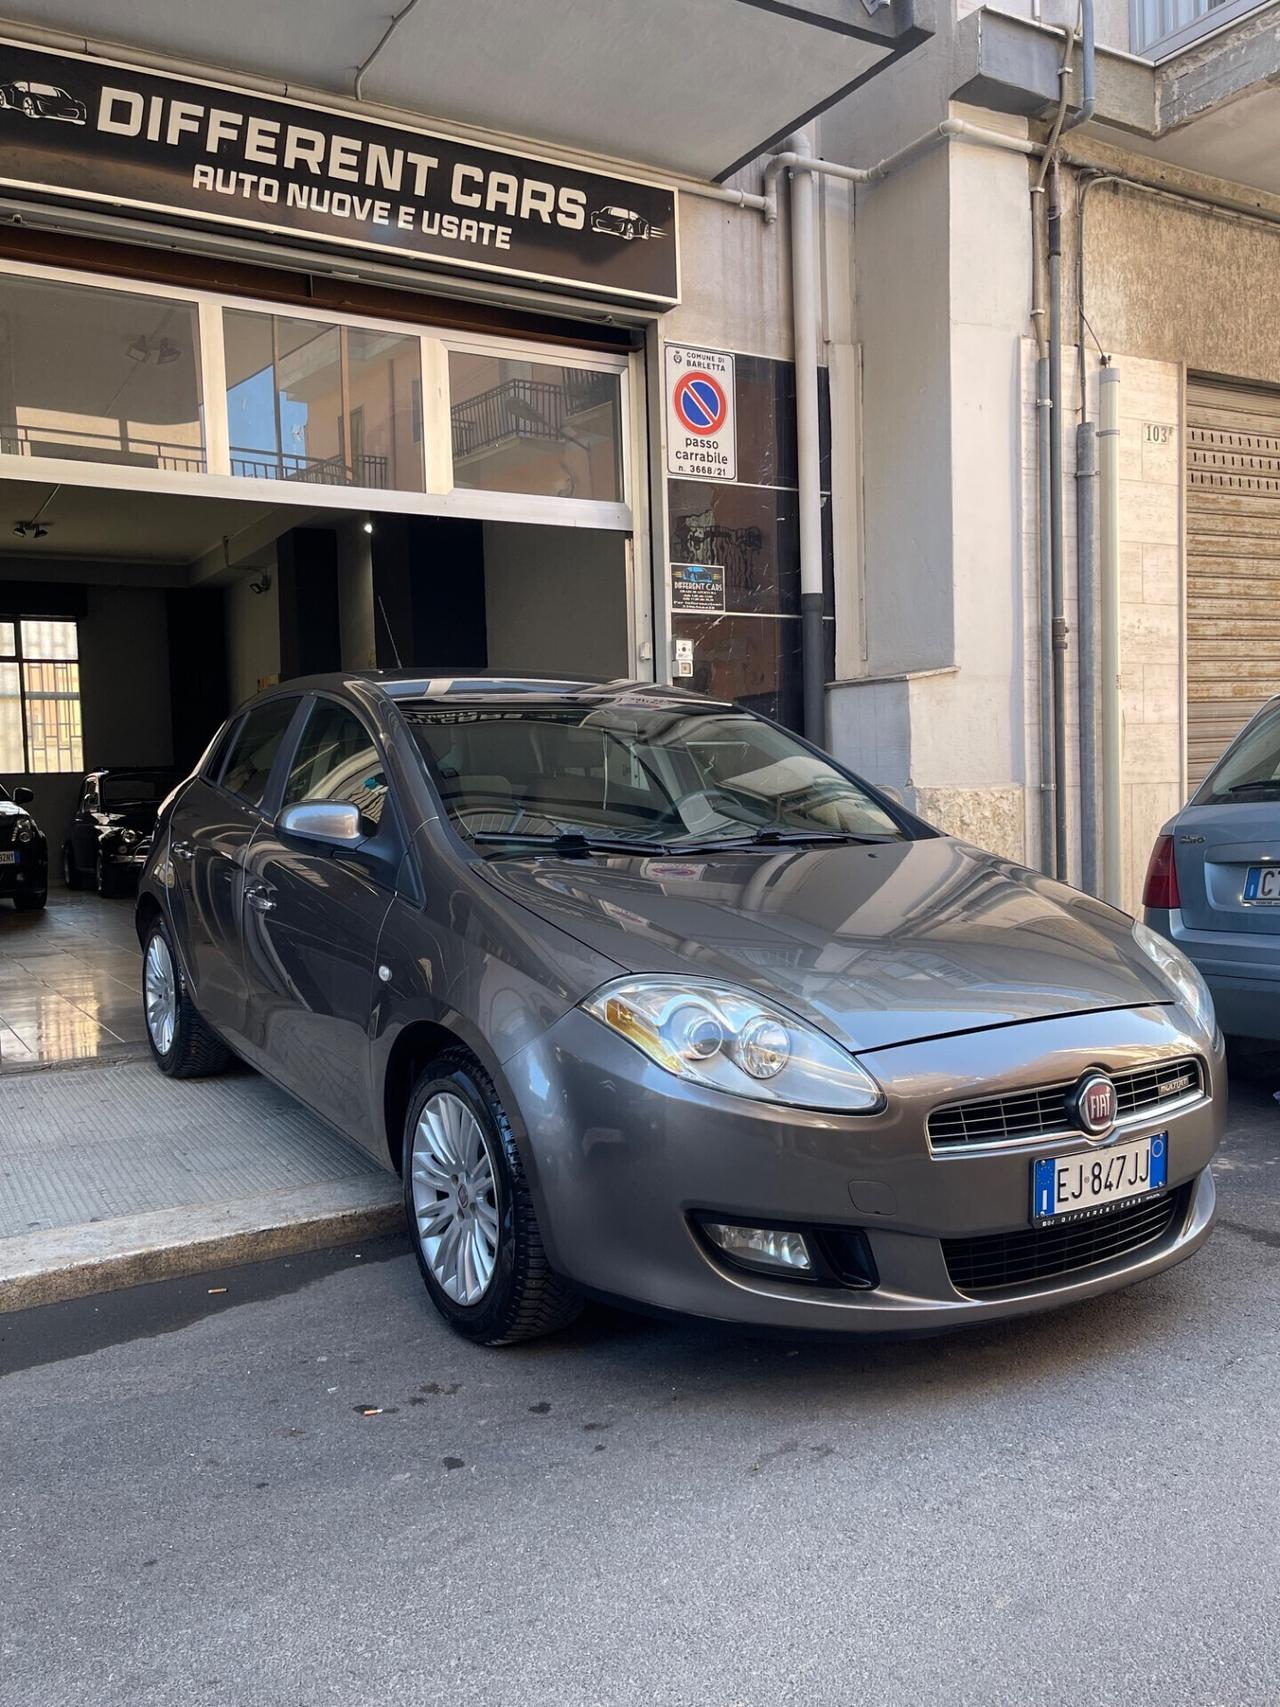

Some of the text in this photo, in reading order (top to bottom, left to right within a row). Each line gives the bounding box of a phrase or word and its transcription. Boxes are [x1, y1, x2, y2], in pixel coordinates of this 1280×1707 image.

[97, 86, 587, 230] DIFFERENT CARS
[193, 163, 512, 250] AUTO NUOVE E USATE
[686, 352, 715, 362] COMUNE
[686, 360, 726, 372] BARLETTA
[685, 437, 719, 449] passo
[675, 450, 728, 465] carrabile
[1261, 870, 1280, 897] C
[1089, 1091, 1111, 1120] FIAT
[1057, 1164, 1083, 1203] EJ
[1091, 1149, 1150, 1196] 847JJ
